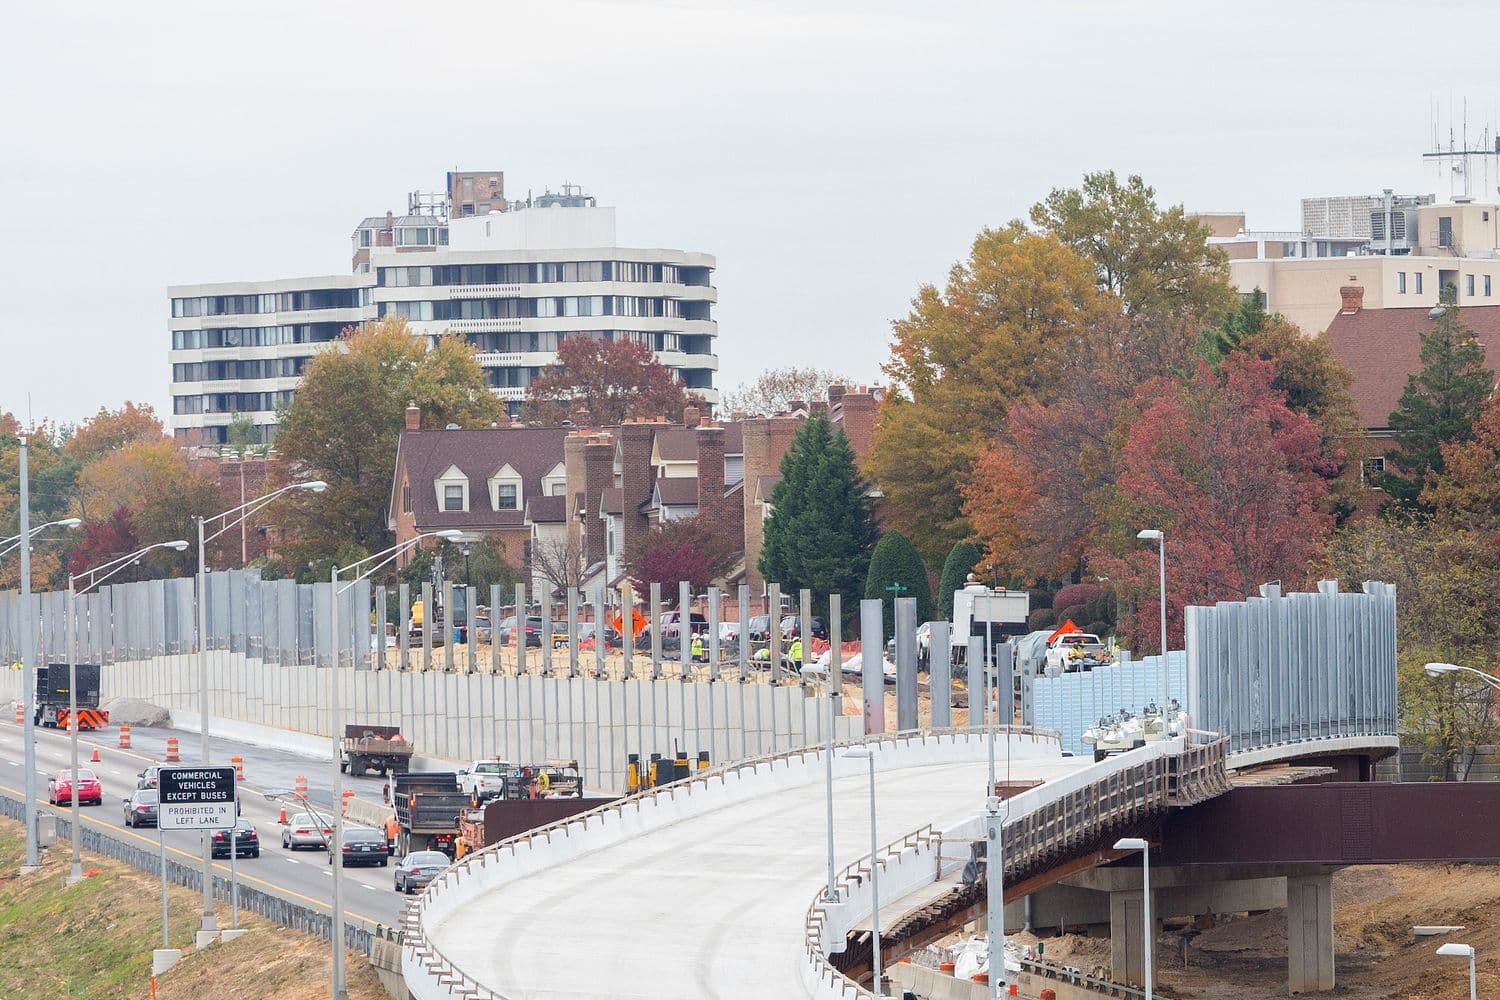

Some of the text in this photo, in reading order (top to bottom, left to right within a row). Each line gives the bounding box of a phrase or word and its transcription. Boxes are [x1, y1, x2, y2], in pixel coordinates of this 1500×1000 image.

[171, 771, 223, 780] COMMERCIAL
[178, 781, 217, 790] VEHICLES
[166, 791, 228, 801] EXCEPT BUSES
[168, 806, 227, 815] PROHIBITED IN
[175, 816, 220, 825] LEFT LANE
